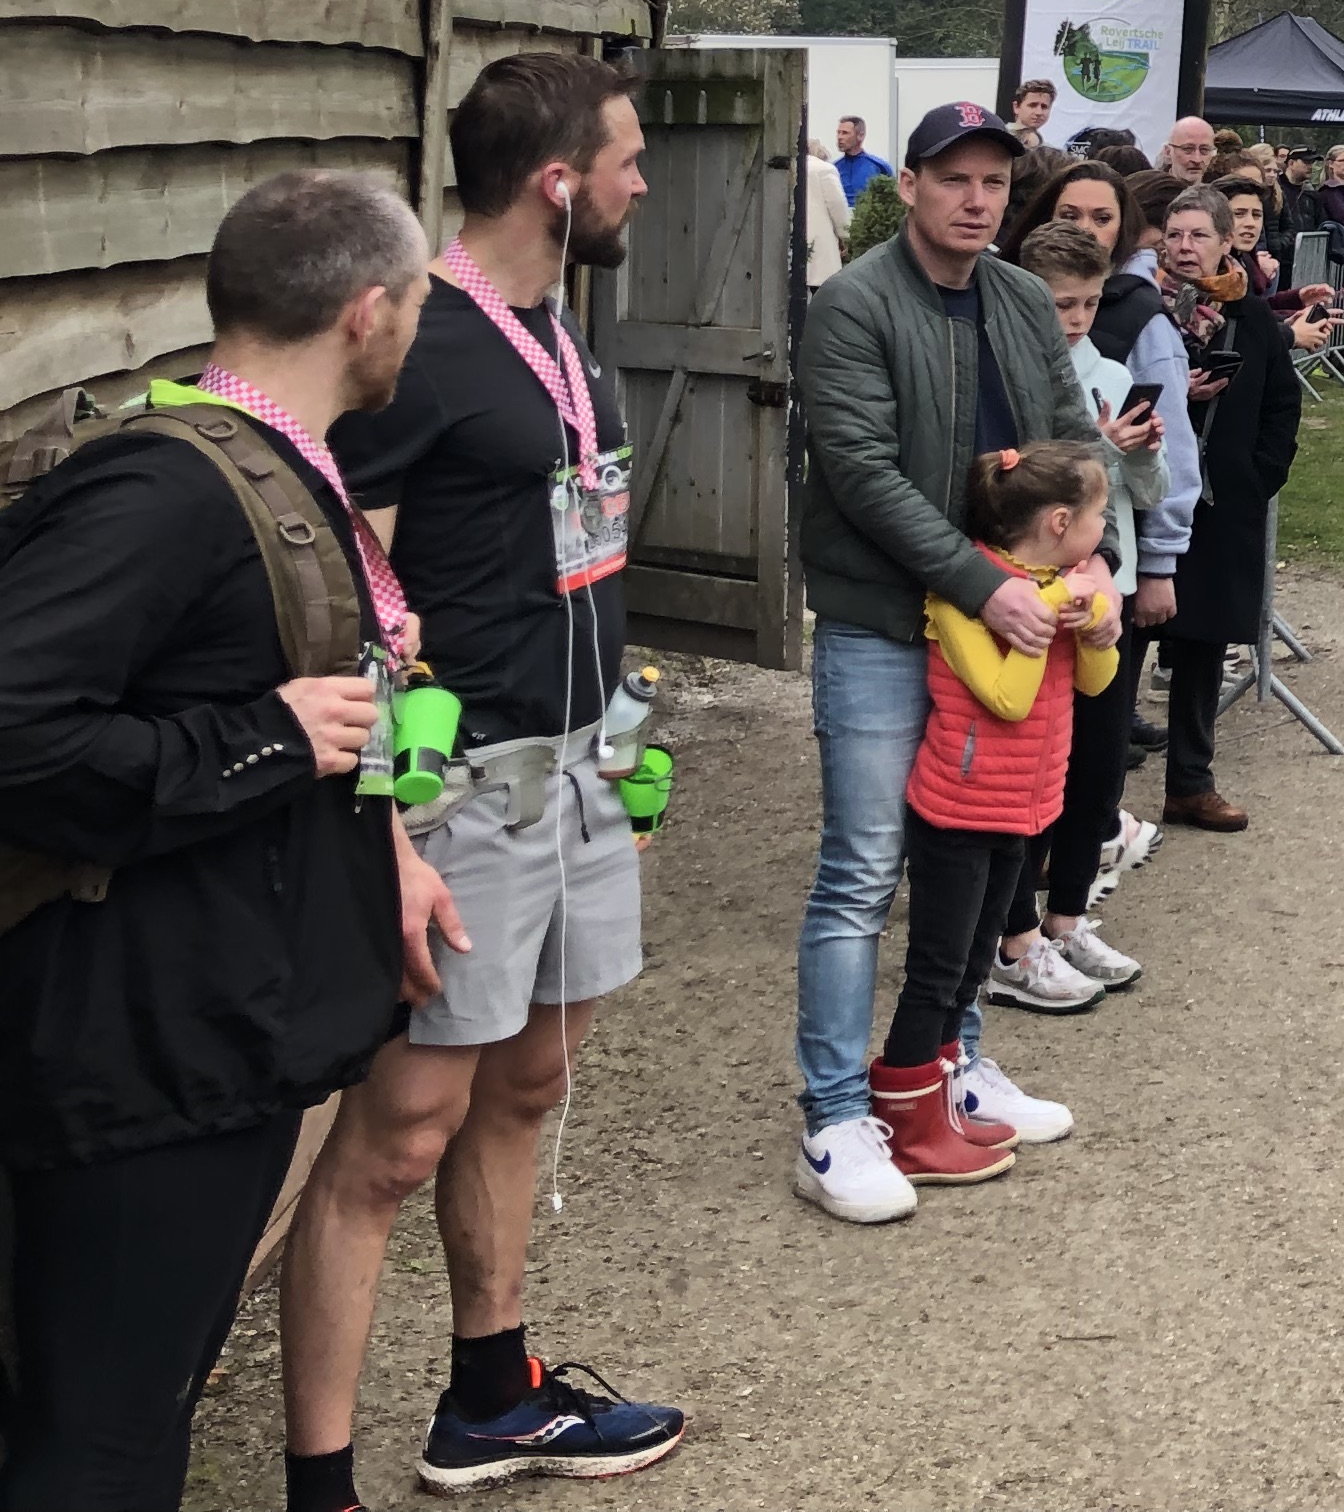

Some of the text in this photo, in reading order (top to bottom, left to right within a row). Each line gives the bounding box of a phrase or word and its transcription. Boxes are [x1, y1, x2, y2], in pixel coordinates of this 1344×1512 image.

[1100, 25, 1164, 40] Rovertsche
[1106, 37, 1160, 51] Leij TRAIL
